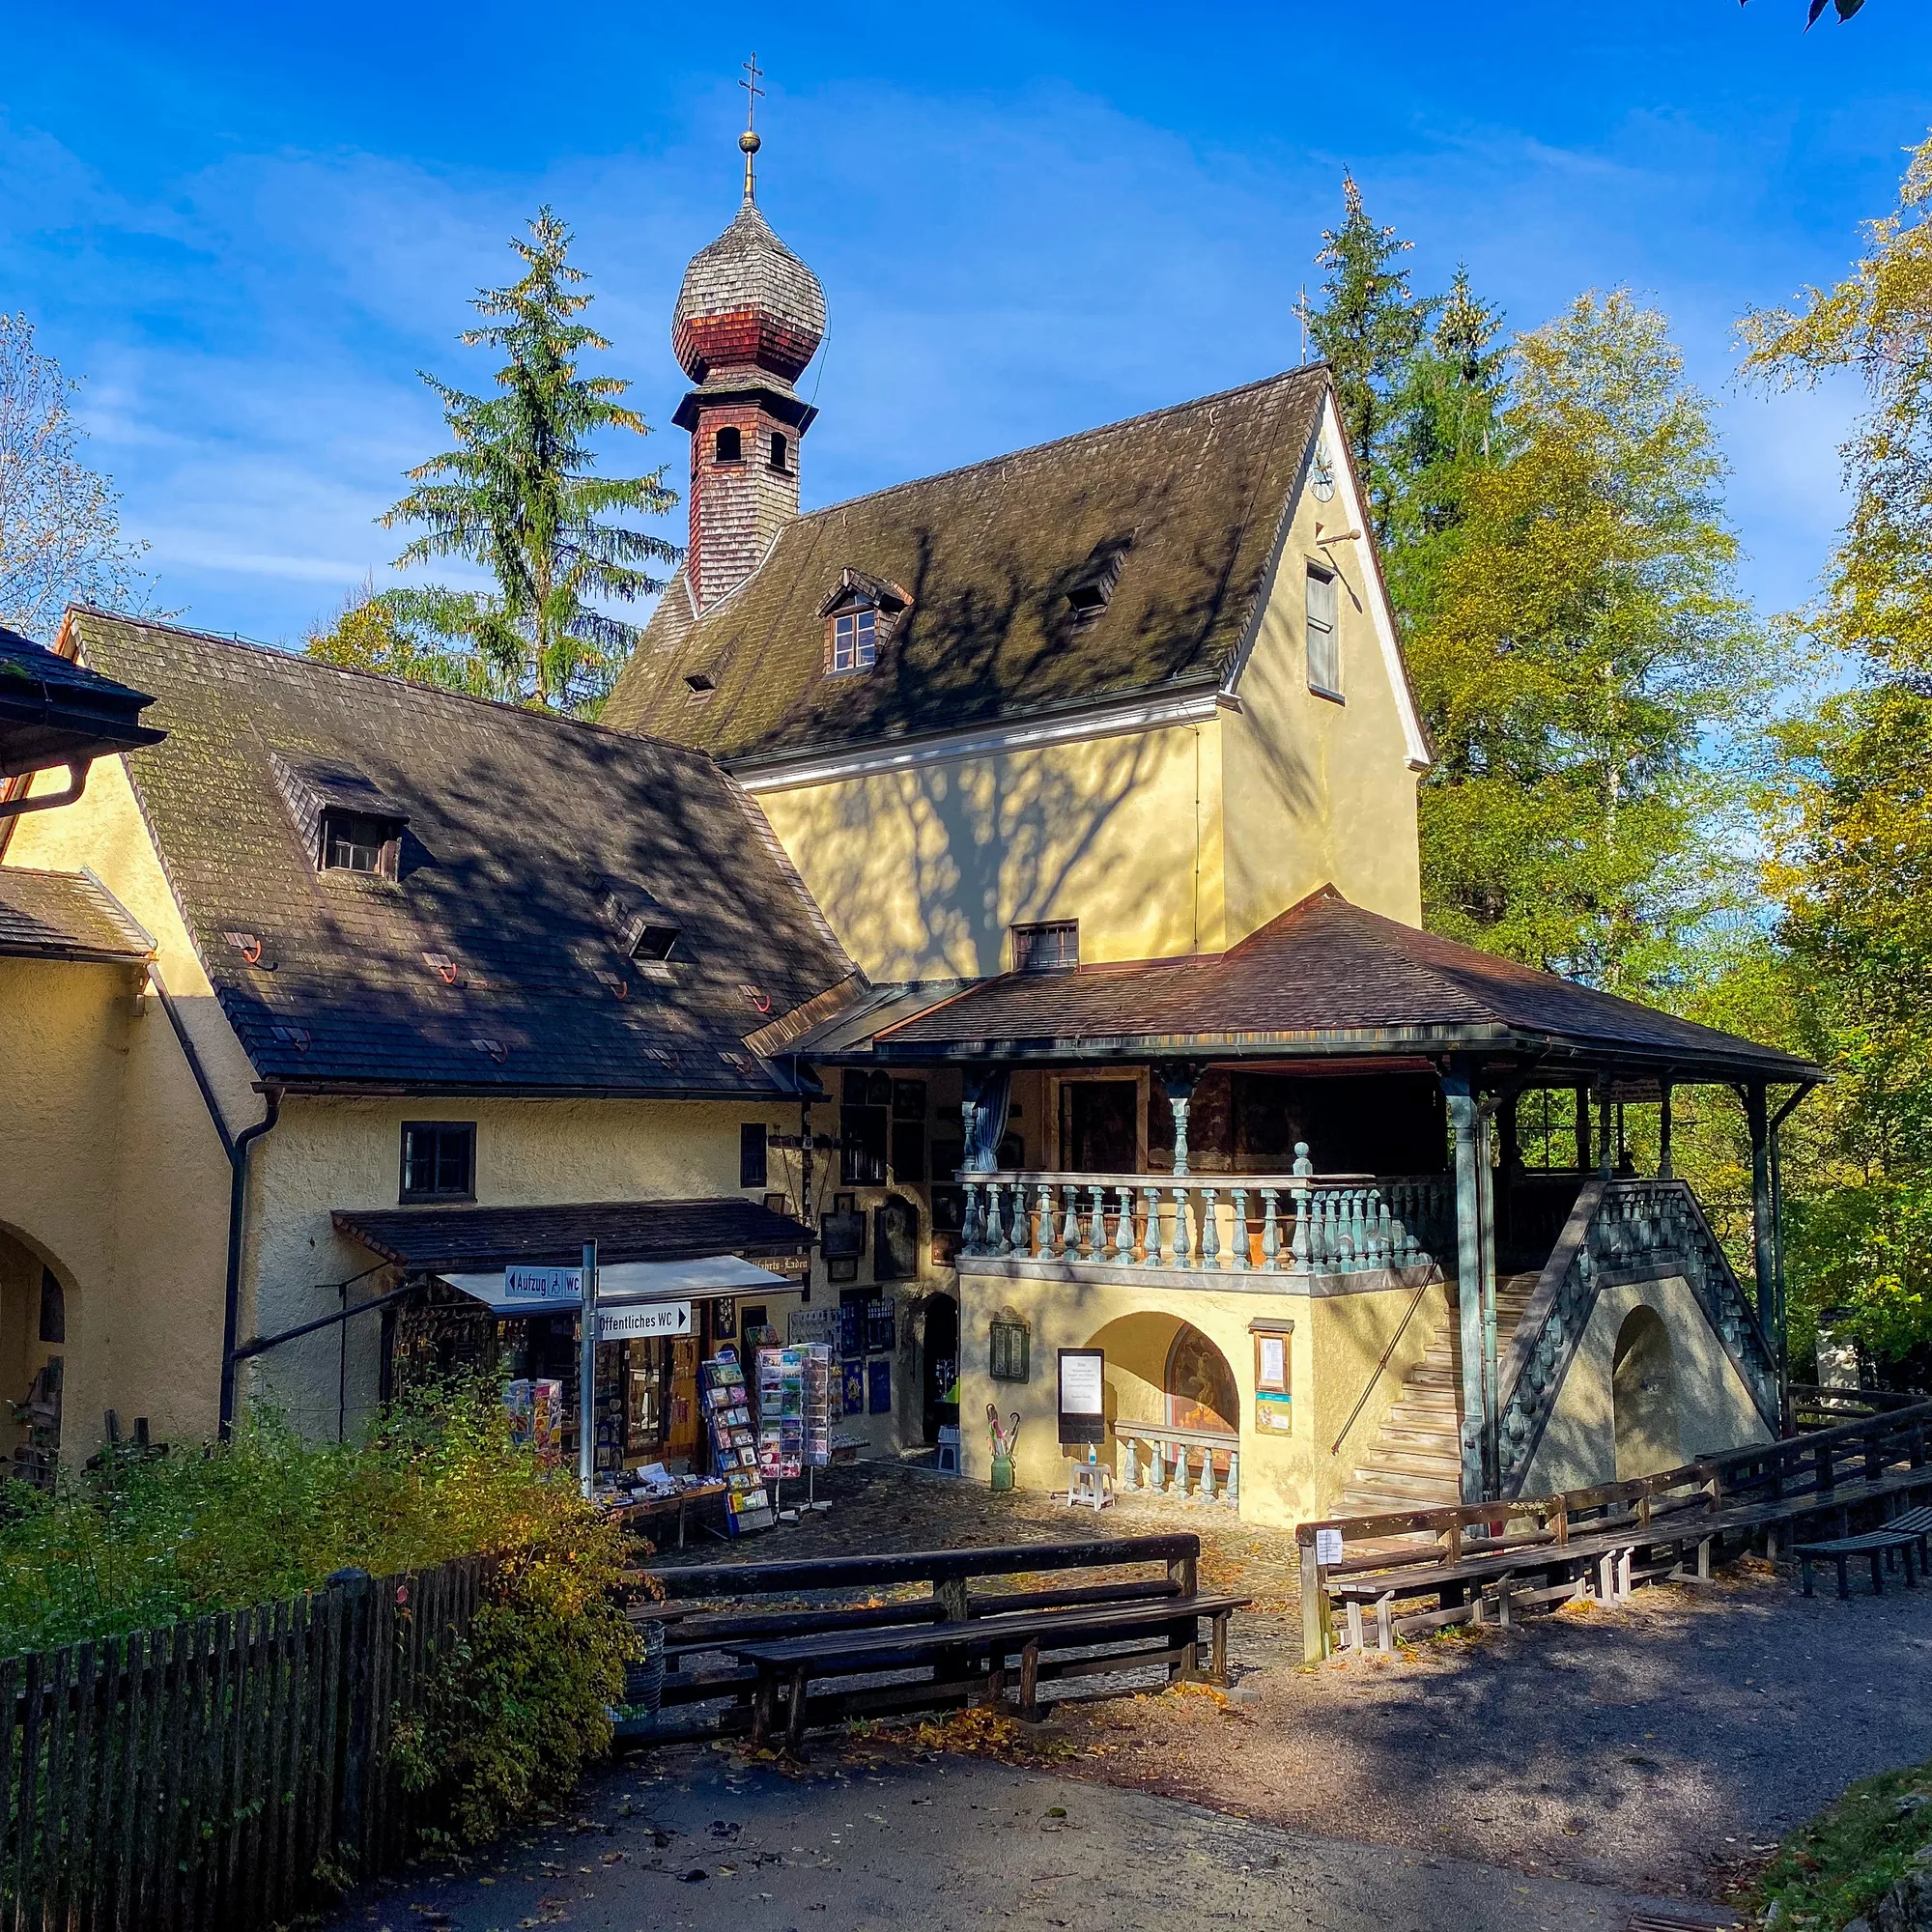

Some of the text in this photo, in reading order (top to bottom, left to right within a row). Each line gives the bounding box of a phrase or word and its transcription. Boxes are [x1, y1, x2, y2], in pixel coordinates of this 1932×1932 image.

[517, 1272, 580, 1296] Aufzug WC
[599, 1312, 672, 1331] Öffentliches WC
